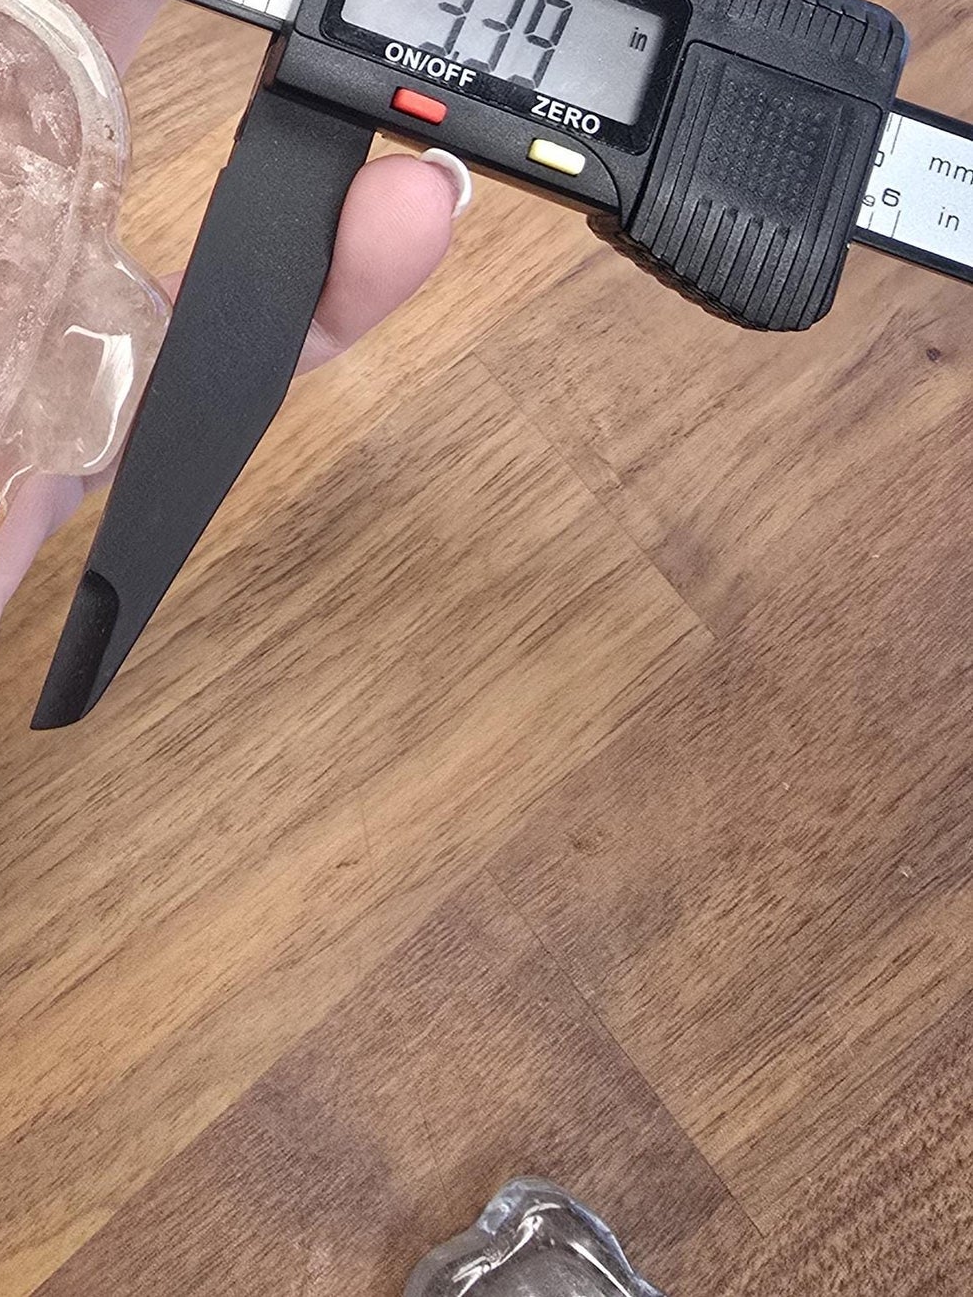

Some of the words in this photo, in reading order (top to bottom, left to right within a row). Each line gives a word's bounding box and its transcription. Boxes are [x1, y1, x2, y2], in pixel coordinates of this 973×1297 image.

[629, 27, 648, 52] in
[384, 42, 477, 87] ON/OFF
[531, 95, 601, 135] ZERO
[929, 156, 973, 185] mm
[882, 187, 901, 207] 6
[938, 206, 960, 231] in
